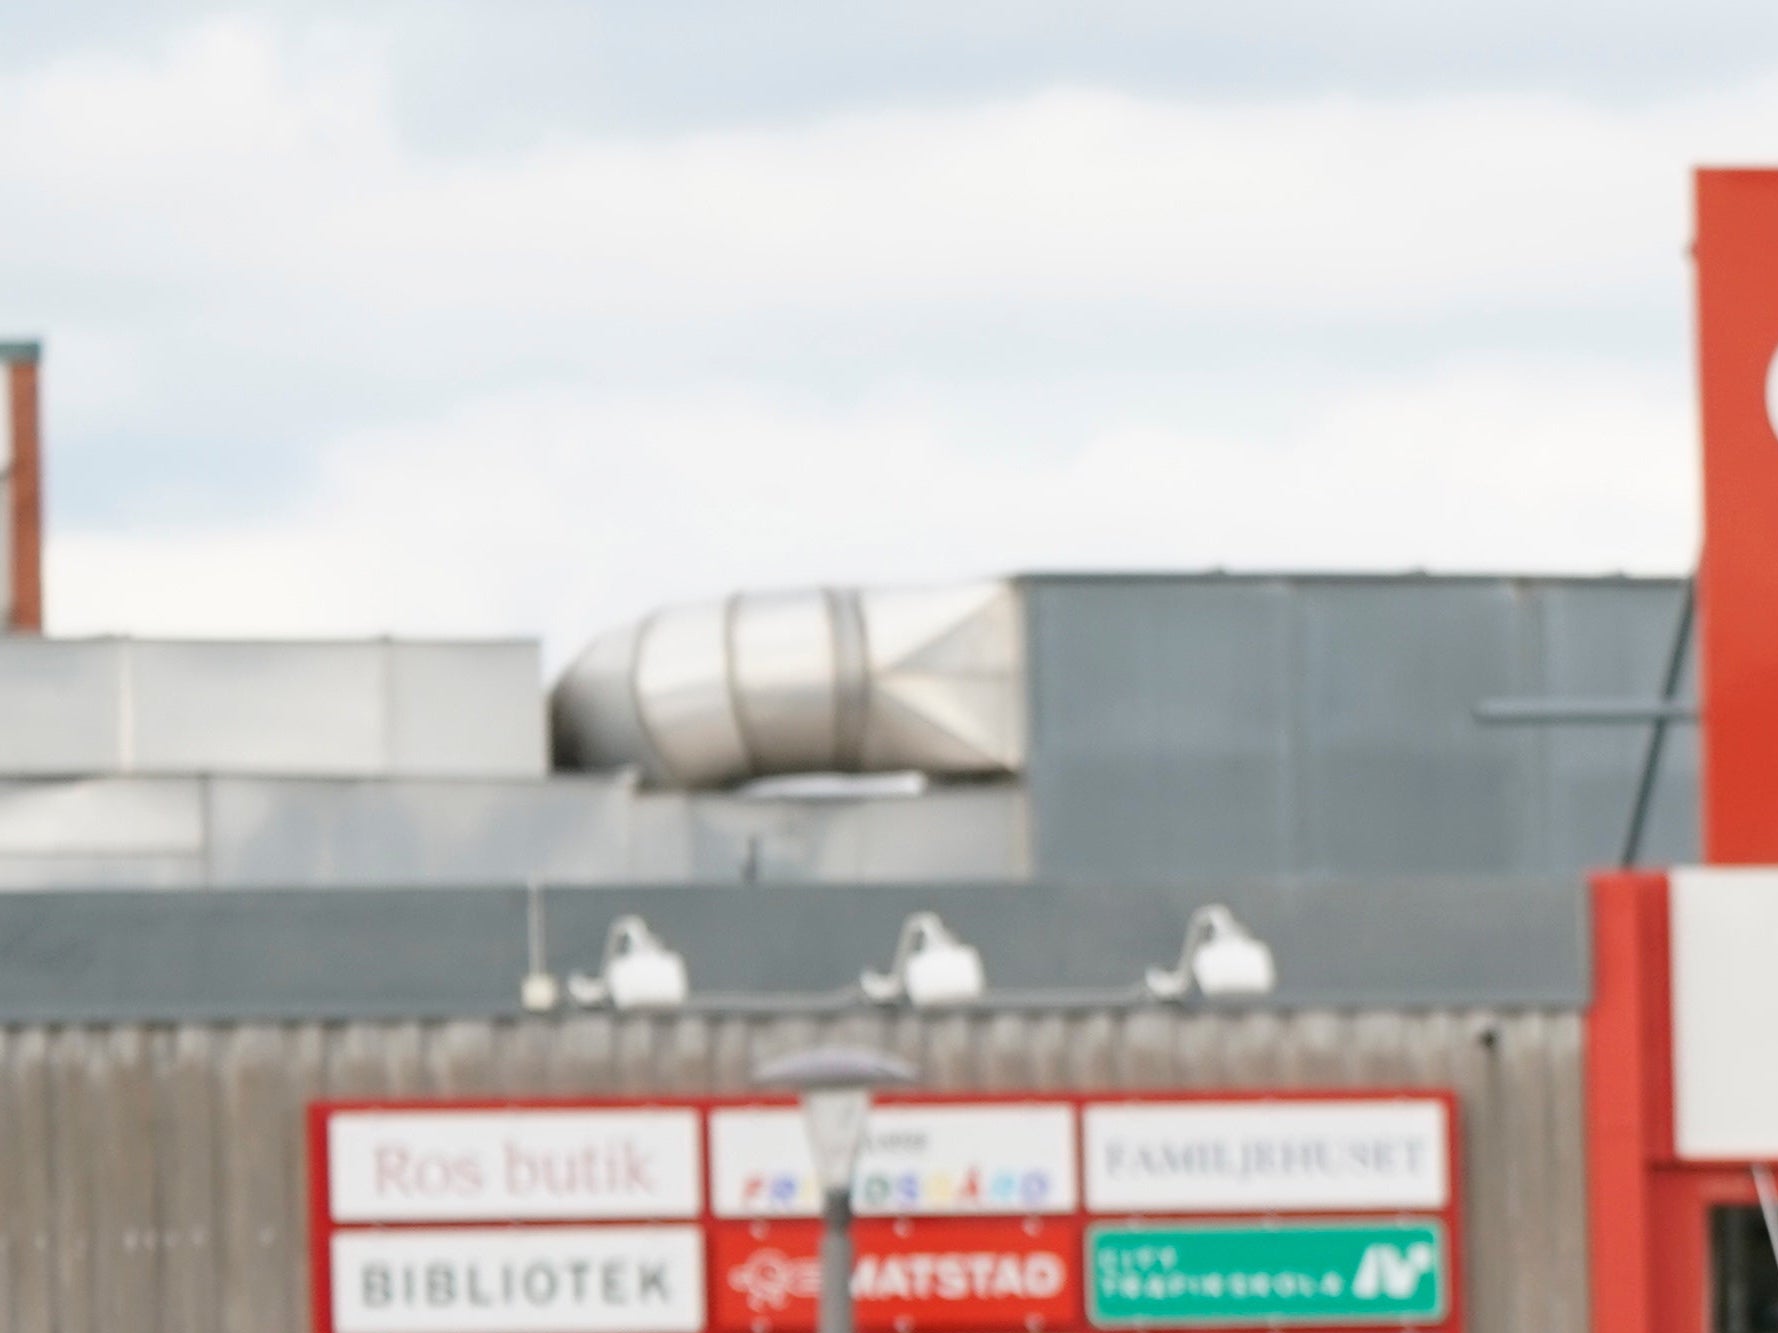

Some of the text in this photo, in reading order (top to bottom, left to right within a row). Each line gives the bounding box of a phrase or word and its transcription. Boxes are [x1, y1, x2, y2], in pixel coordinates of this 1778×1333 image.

[374, 1140, 656, 1197] Ros butik
[360, 1257, 672, 1309] BIBLIOTEK
